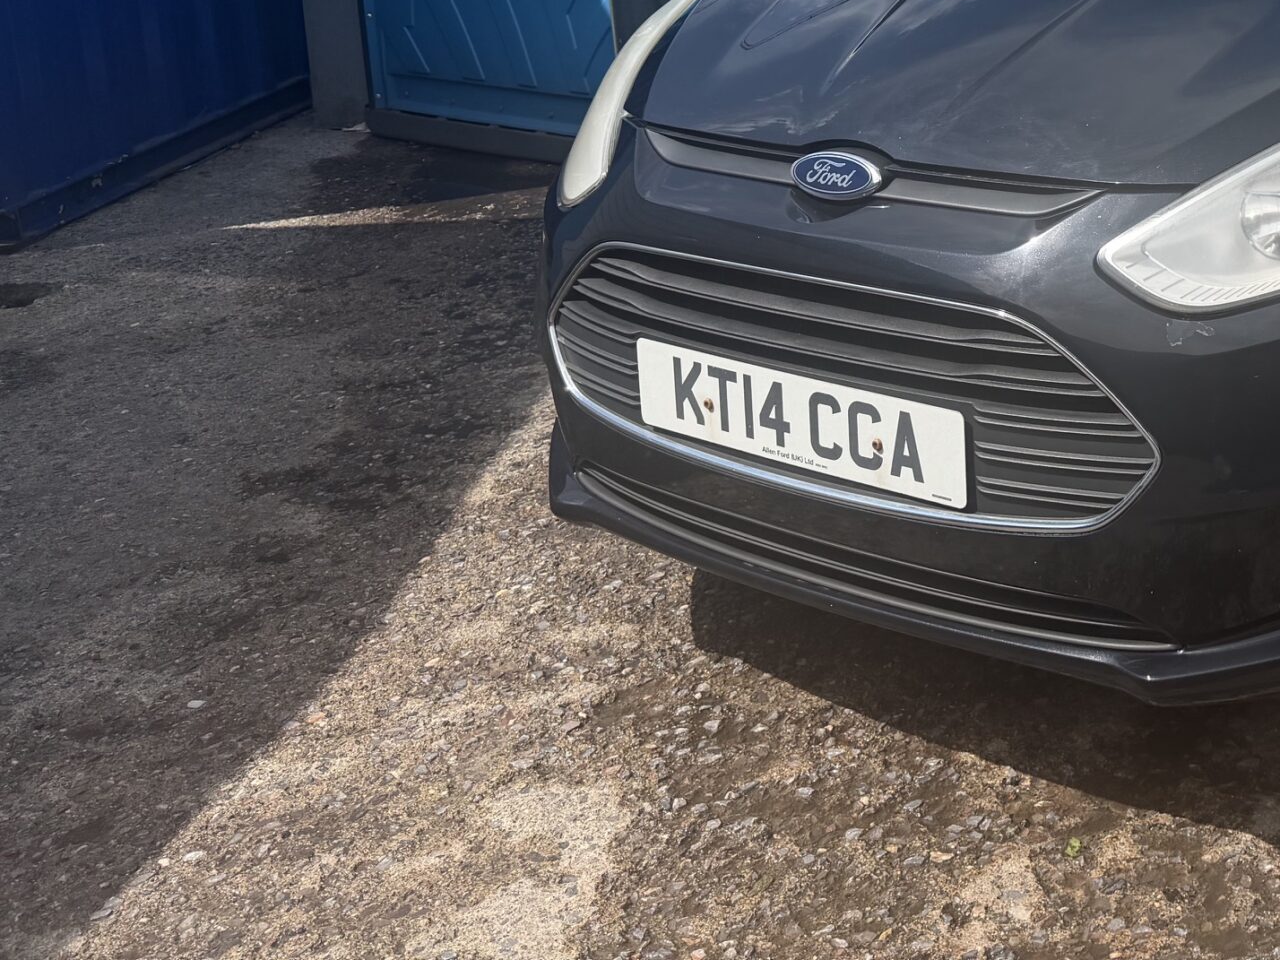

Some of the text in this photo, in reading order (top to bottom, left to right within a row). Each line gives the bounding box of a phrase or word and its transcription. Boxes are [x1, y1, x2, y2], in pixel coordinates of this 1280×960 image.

[806, 159, 857, 188] Ford
[672, 356, 925, 483] KT14 CCA
